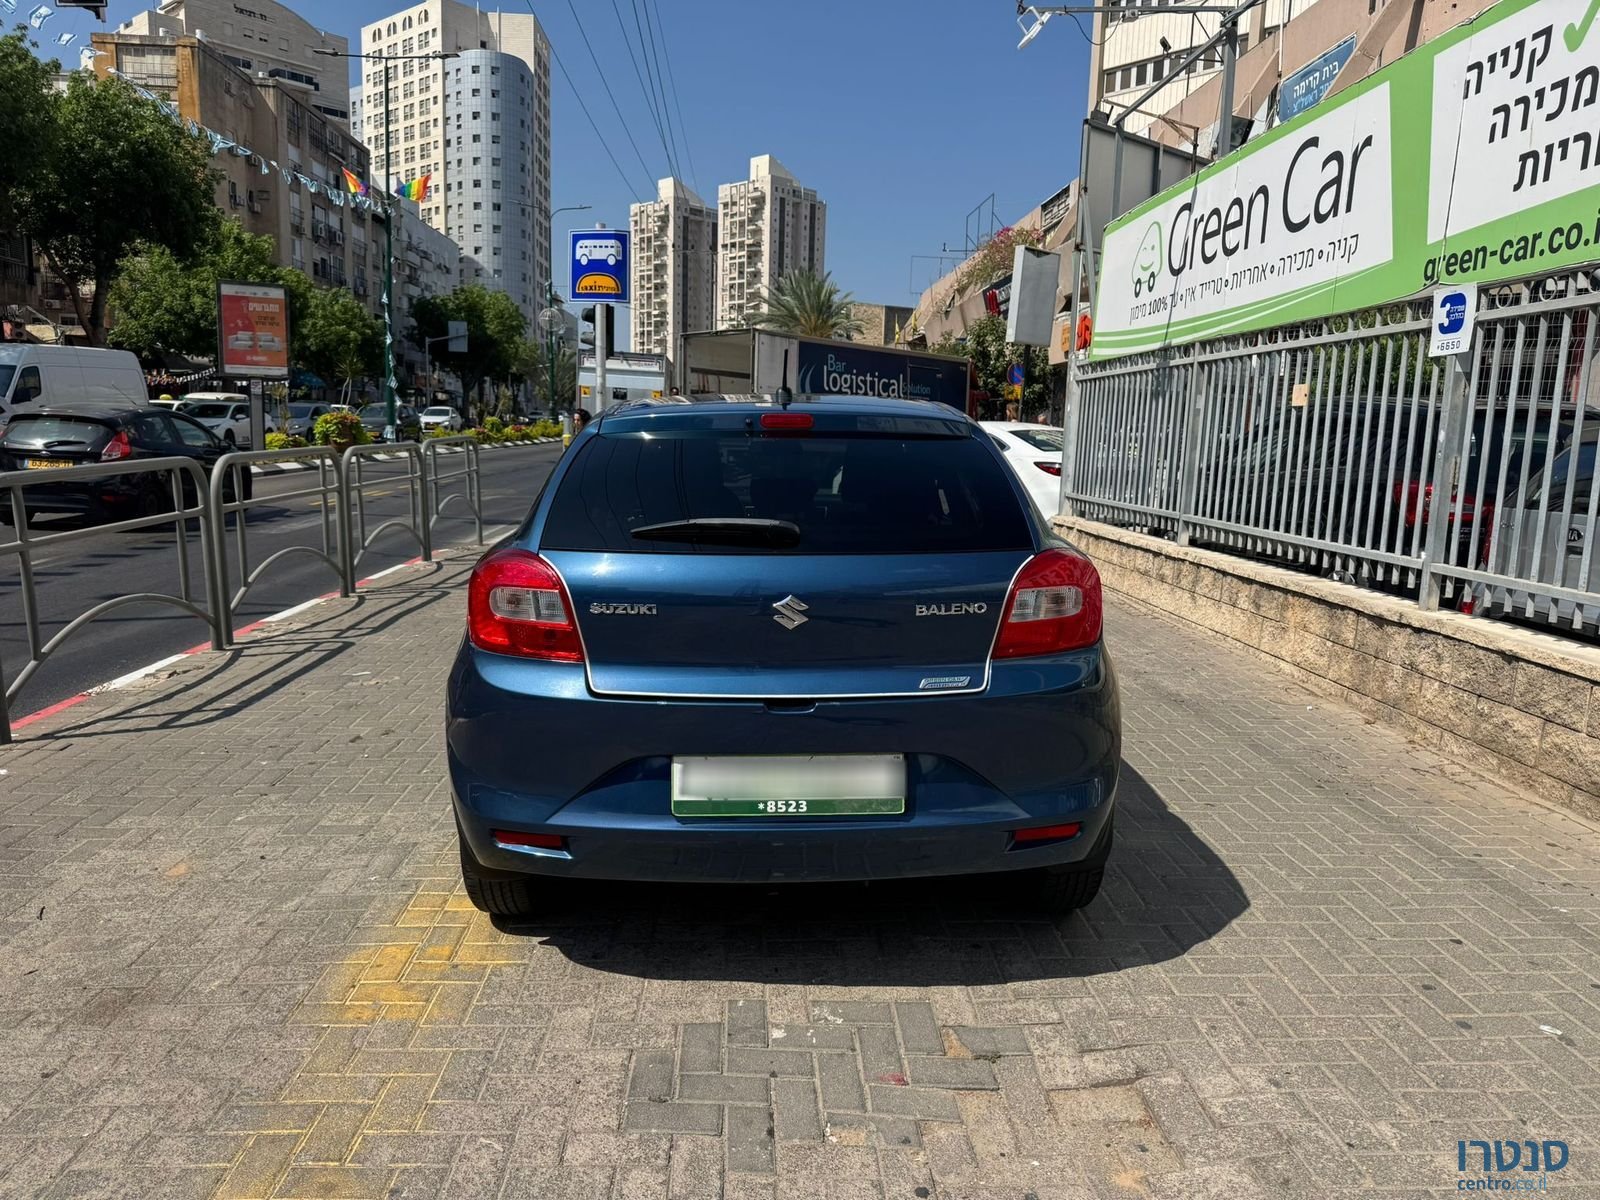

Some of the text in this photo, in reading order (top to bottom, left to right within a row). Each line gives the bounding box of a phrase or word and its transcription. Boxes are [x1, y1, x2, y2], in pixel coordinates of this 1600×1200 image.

[1462, 24, 1554, 100] קנייה
[1293, 61, 1339, 98] בית קדימה
[1488, 65, 1600, 144] מכירה
[1512, 128, 1600, 193] ריות
[1167, 134, 1373, 277] Green Car
[1277, 247, 1315, 277] מכירה
[1326, 233, 1359, 264] קניה
[581, 280, 597, 291] taxi
[1199, 277, 1223, 299] טרייד
[1230, 262, 1268, 291] אחריות
[1148, 296, 1168, 316] 100%
[1184, 285, 1197, 309] אין
[1129, 303, 1147, 326] מימון
[827, 353, 847, 372] Bar
[823, 364, 904, 398] logistical
[589, 602, 657, 615] SUZUKI
[915, 602, 988, 617] BALENO
